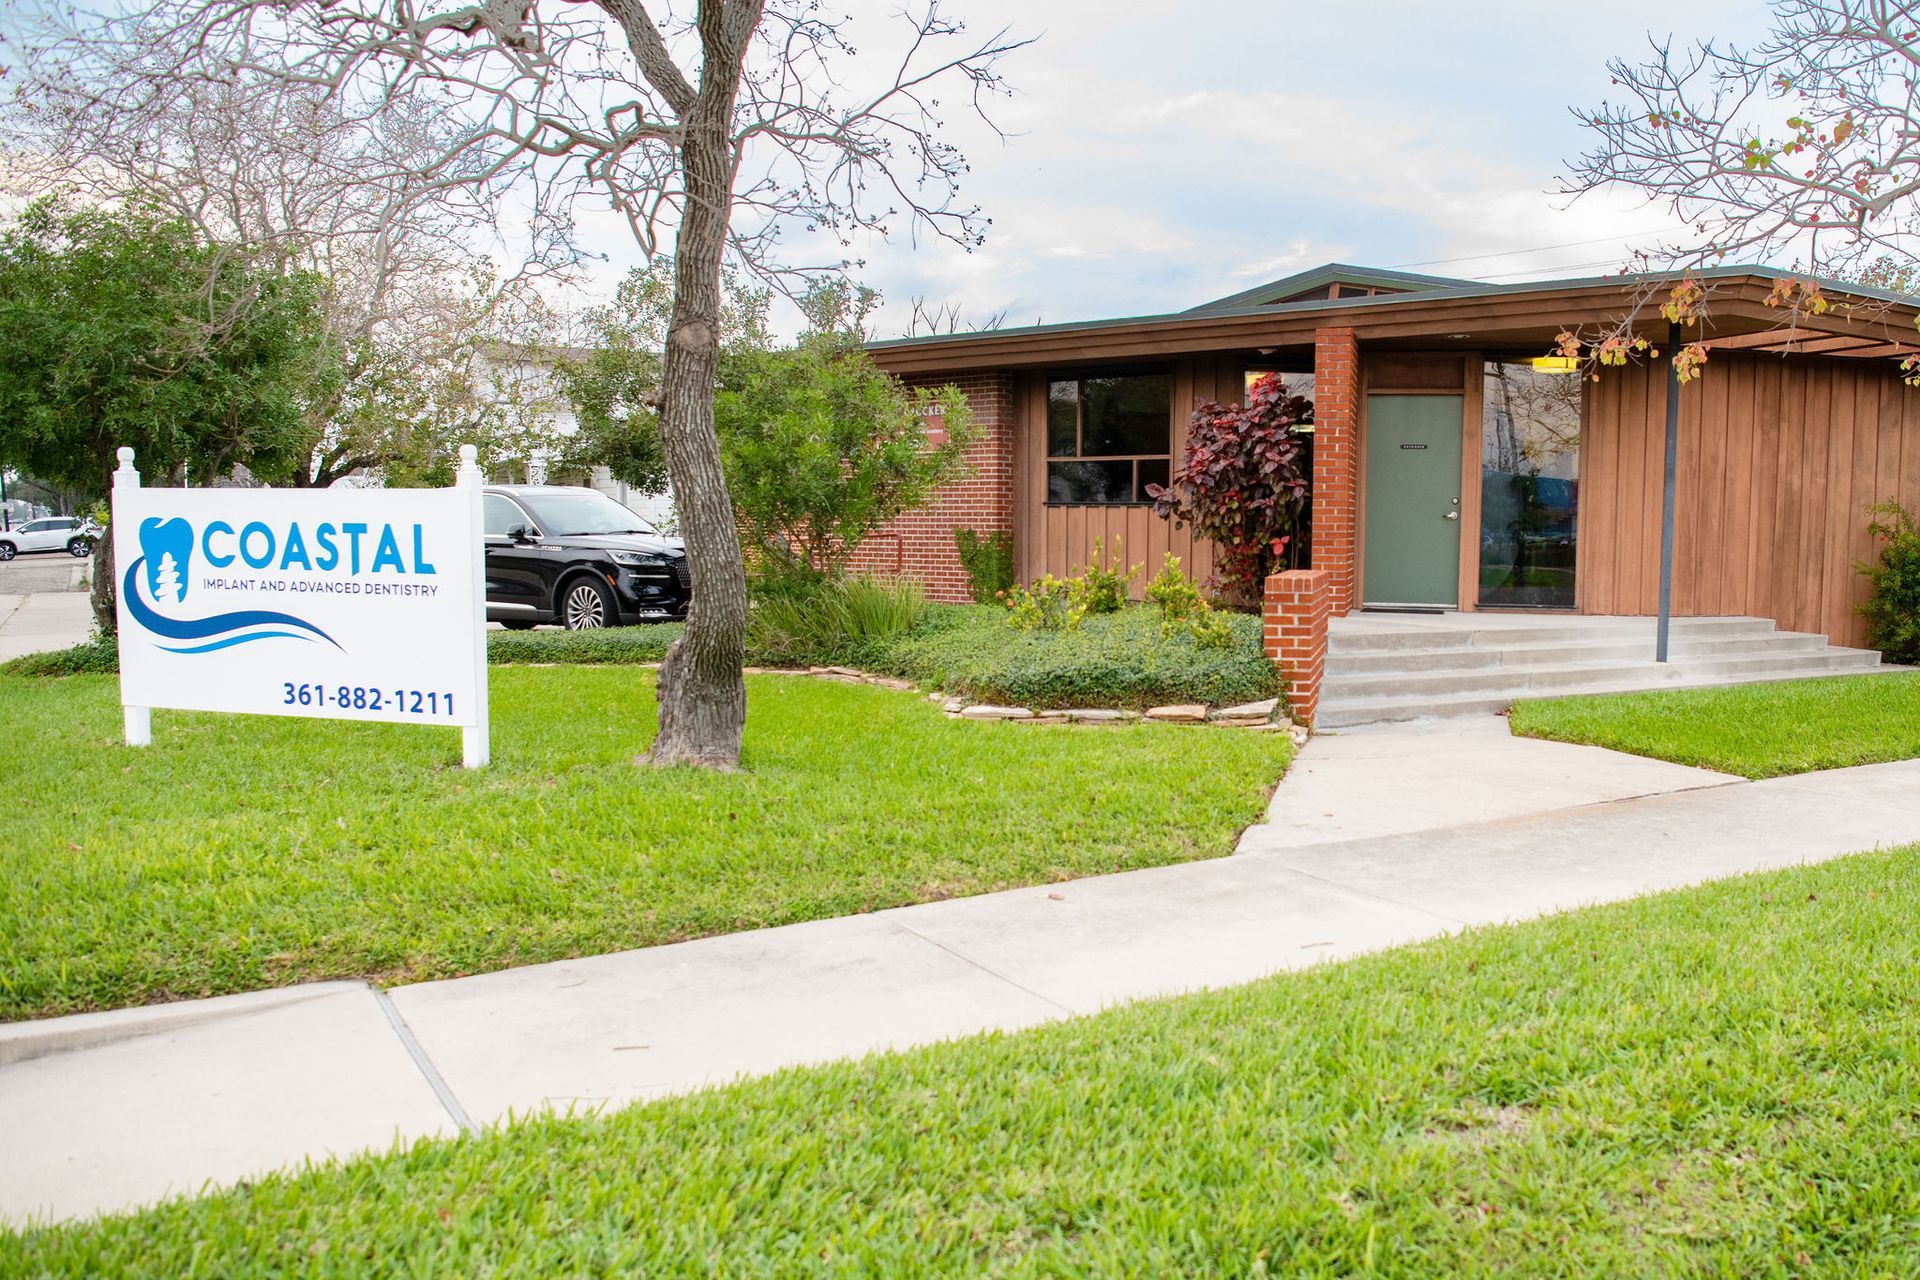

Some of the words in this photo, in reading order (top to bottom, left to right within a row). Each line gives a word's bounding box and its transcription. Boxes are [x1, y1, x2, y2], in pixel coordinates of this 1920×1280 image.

[202, 521, 436, 576] COASTAL
[203, 578, 256, 591] IMPLANT
[260, 581, 286, 591] AND
[290, 581, 360, 593] ADVANCED
[365, 583, 438, 597] DENTISTRY
[284, 682, 453, 716] 361-882-1211
